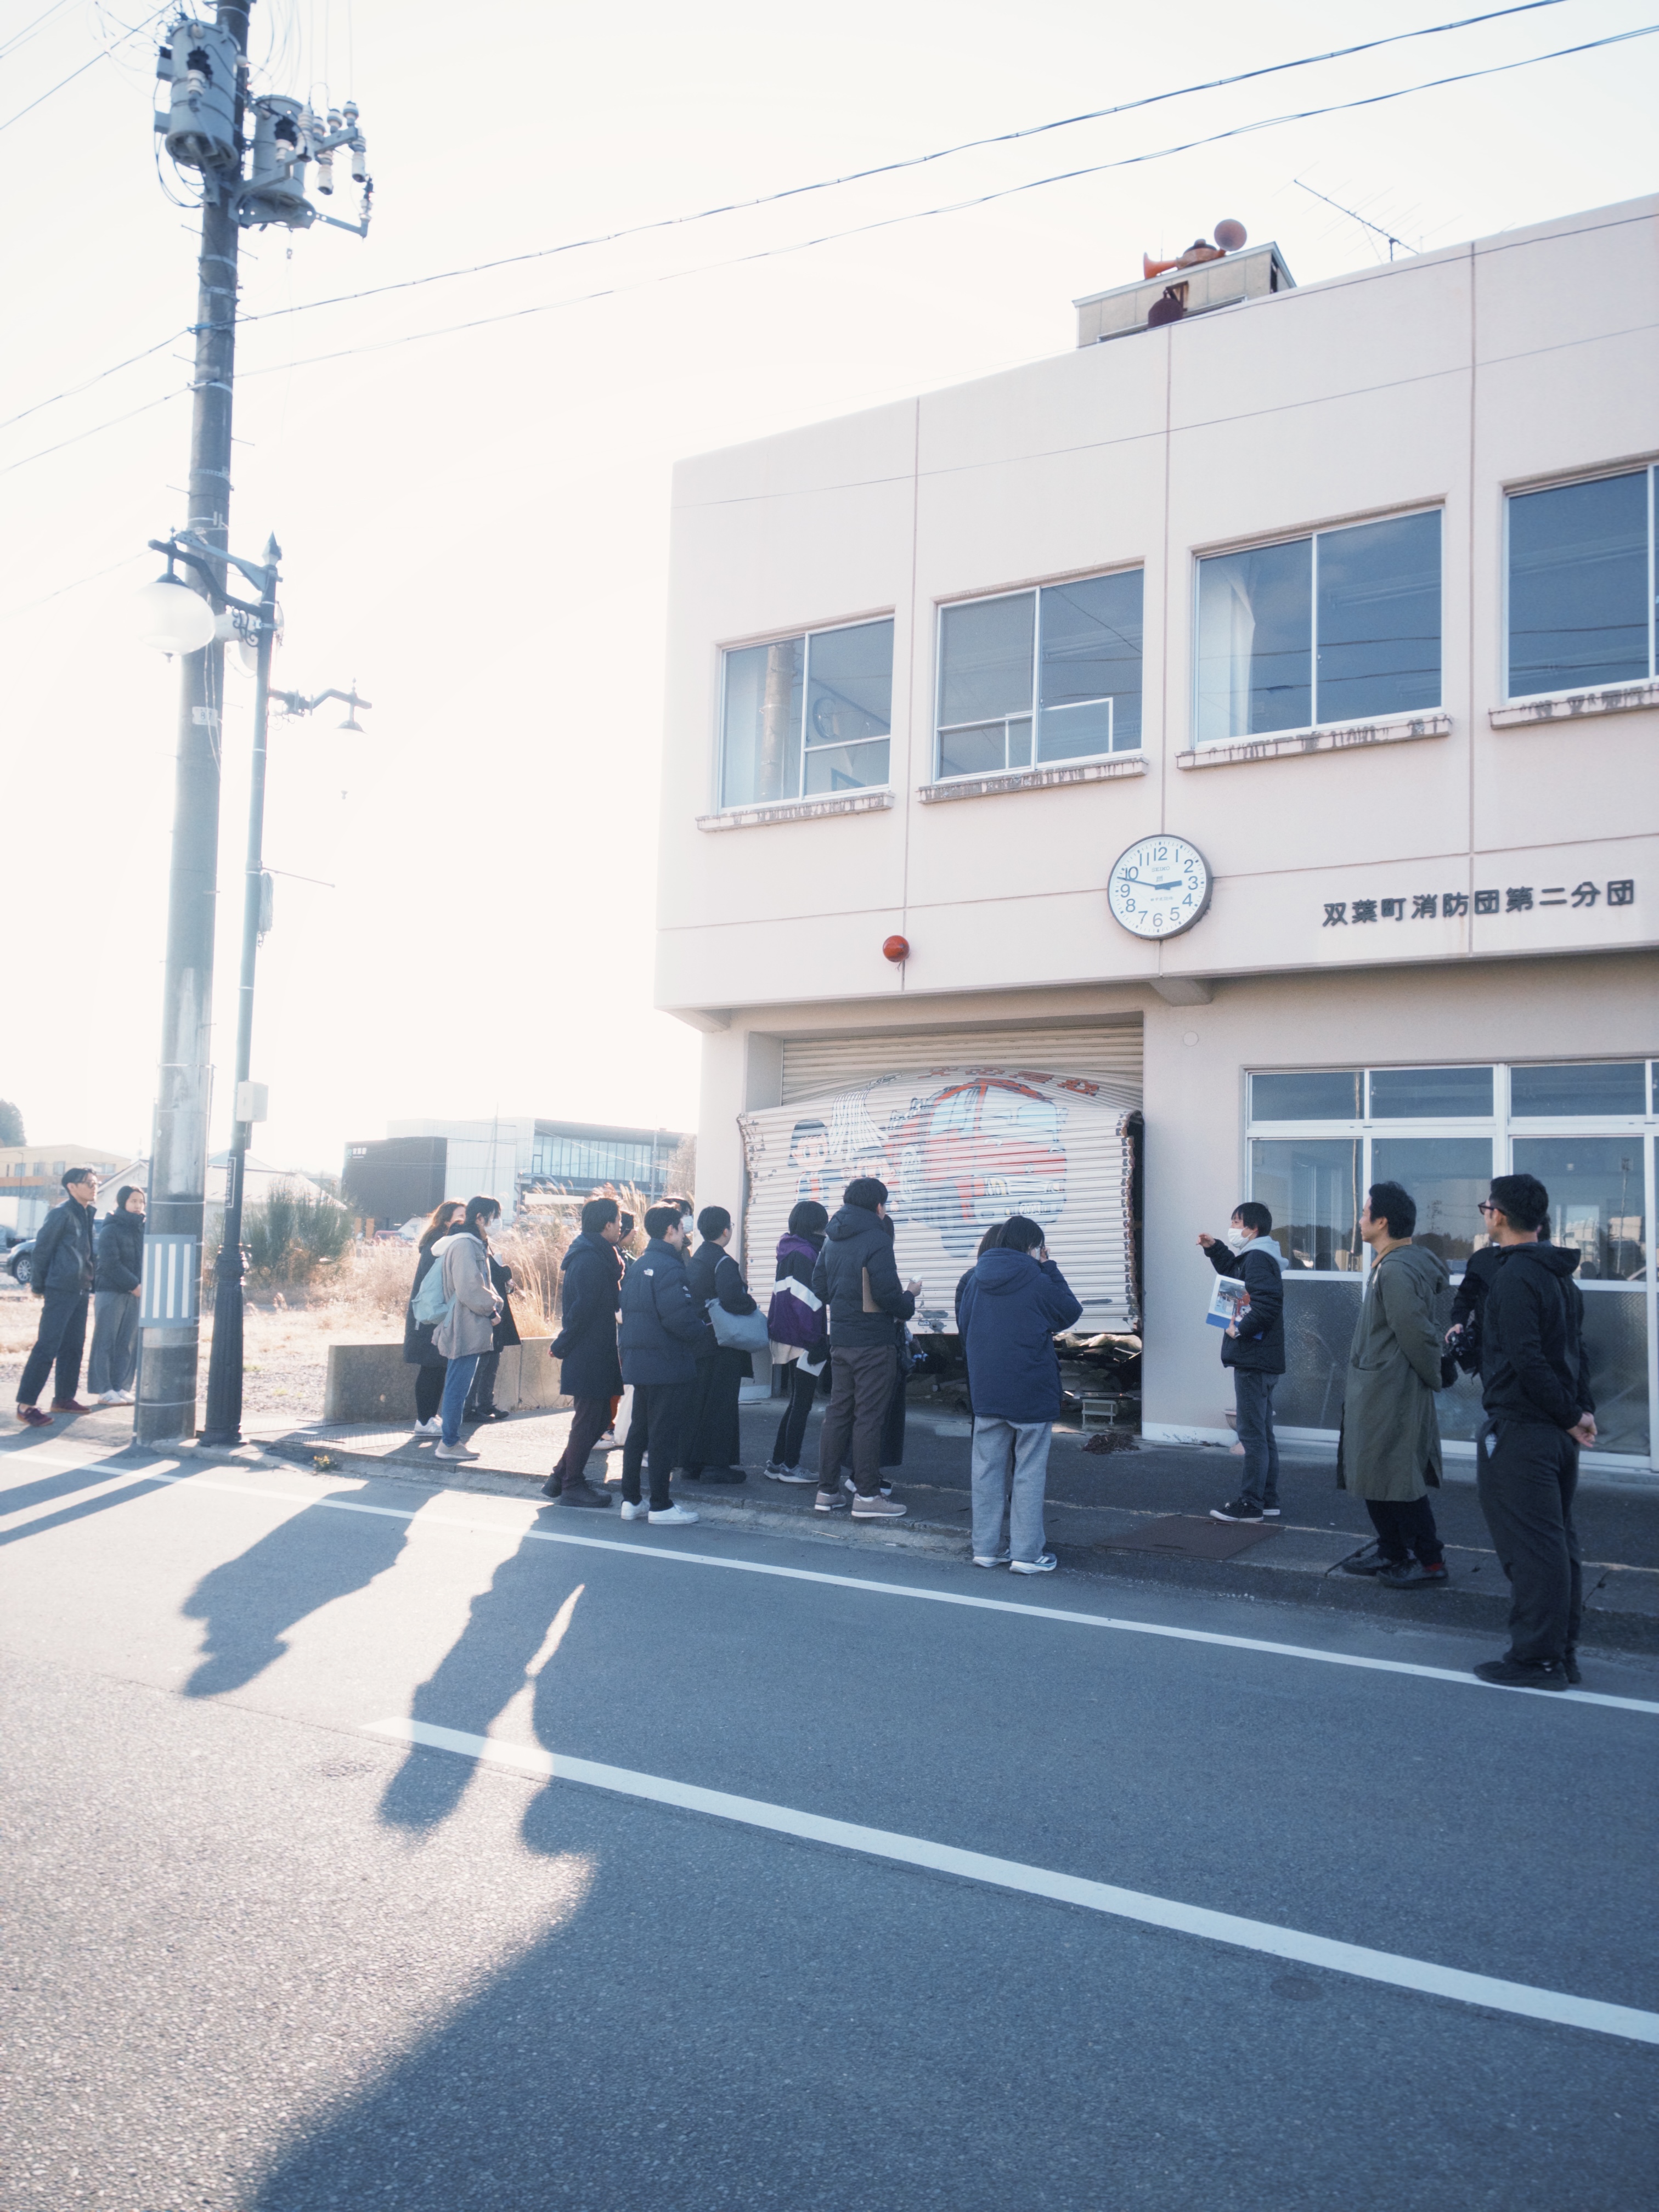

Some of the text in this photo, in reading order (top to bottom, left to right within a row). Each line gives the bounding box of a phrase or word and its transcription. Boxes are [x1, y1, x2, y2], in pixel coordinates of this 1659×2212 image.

[1139, 852, 1149, 867] 11
[1154, 847, 1167, 861] 12
[1175, 849, 1178, 863] 1
[1183, 859, 1194, 873] 2
[1125, 866, 1139, 881] 10
[1188, 876, 1199, 890] 3
[1120, 884, 1131, 898] 9
[1125, 899, 1136, 913] 8
[1182, 893, 1193, 907] 4
[1322, 879, 1634, 927] 双葉町消防団第二分団
[1138, 911, 1148, 924] 7
[1153, 913, 1163, 927] 6
[1170, 907, 1180, 921] 5
